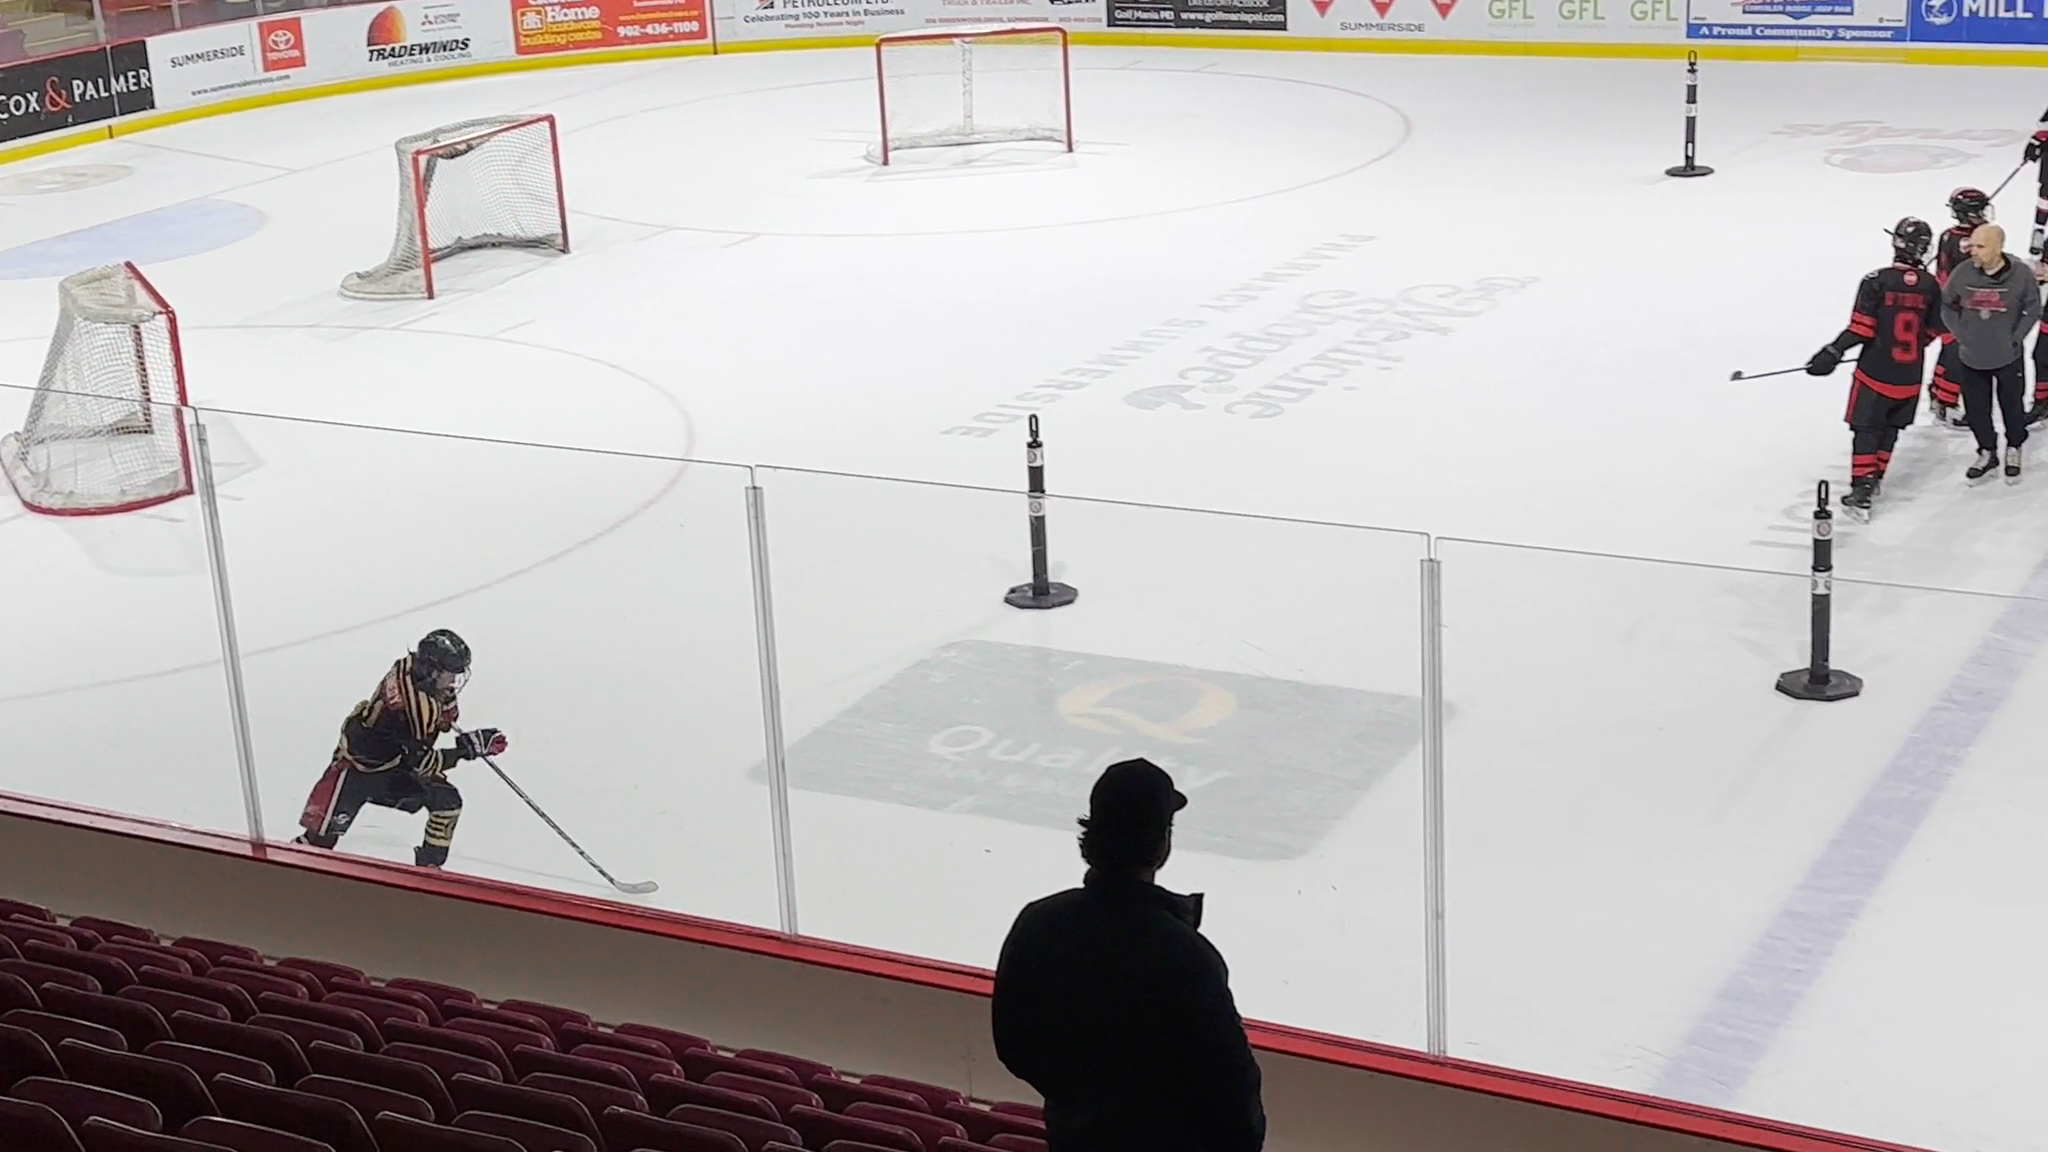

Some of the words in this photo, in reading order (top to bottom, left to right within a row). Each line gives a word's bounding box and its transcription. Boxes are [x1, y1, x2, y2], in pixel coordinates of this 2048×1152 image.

[546, 6, 600, 22] Home
[743, 13, 800, 24] Celebrating
[802, 11, 821, 20] 100
[822, 10, 850, 18] Years
[852, 9, 861, 17] in
[863, 8, 905, 17] Business
[1487, 0, 1535, 20] GFL
[1558, 0, 1606, 21] GFL
[1629, 0, 1679, 22] GFL
[1962, 0, 2034, 18] MILL
[616, 20, 700, 38] 902-436-1100
[1340, 21, 1426, 33] SUMMERSIDE
[1699, 26, 1710, 36] A
[1711, 26, 1753, 36] Proud
[1755, 26, 1835, 39] Community
[1837, 27, 1895, 39] Sponsor
[170, 45, 246, 68] SUMMERSIDE
[265, 49, 301, 60] TOYOTA
[368, 37, 471, 62] TRADEWINDS
[387, 56, 425, 68] HEATING
[433, 51, 473, 62] COOLING
[0, 91, 41, 119] COX
[45, 76, 73, 112] &
[71, 68, 152, 102] PALMER
[1891, 312, 1920, 363] 9
[940, 316, 1208, 438] SUMMERSIDE
[926, 723, 1233, 793] Qualy
